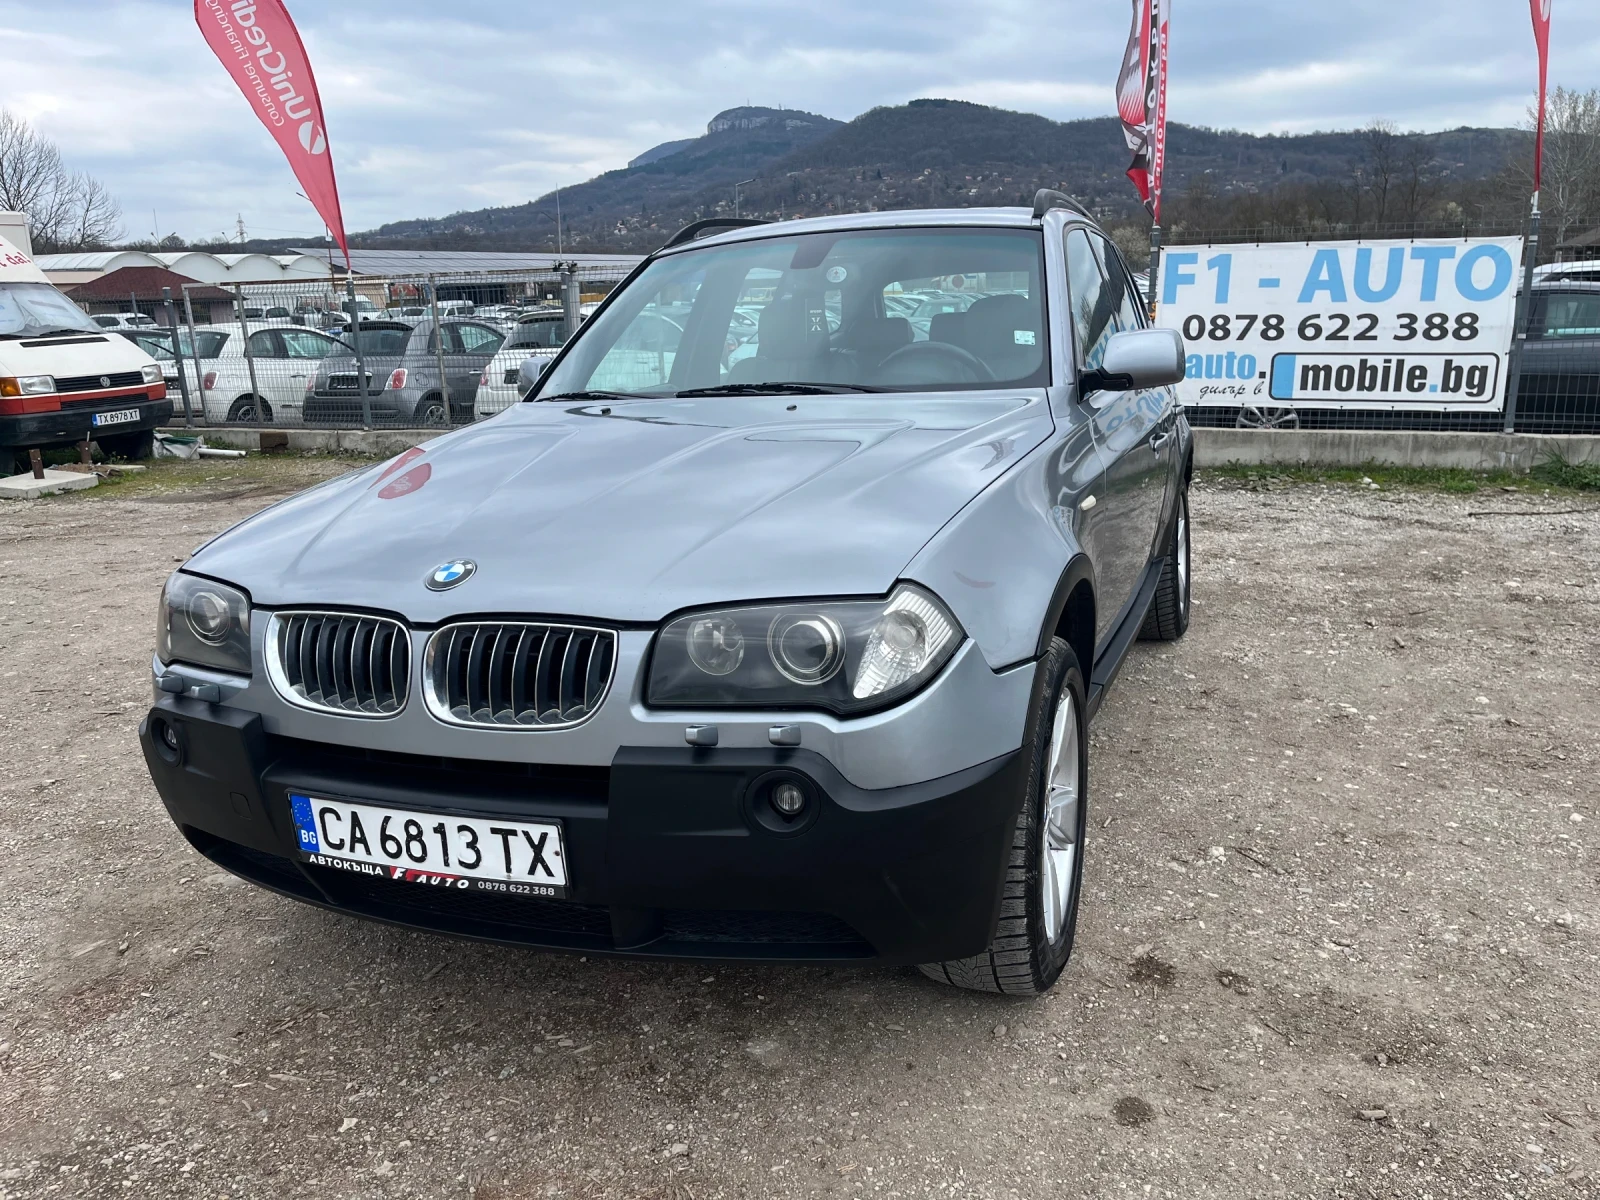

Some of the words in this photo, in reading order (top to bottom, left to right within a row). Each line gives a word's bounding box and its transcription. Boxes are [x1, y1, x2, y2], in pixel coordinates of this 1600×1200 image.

[1162, 252, 1232, 305] F1
[1297, 244, 1513, 304] AUTO
[1182, 314, 1285, 341] 0878
[1297, 313, 1379, 341] 622
[1393, 312, 1479, 341] 388
[1299, 358, 1489, 398] mobile.bg
[301, 829, 317, 844] BG
[309, 854, 383, 875] АВТОКЪЩА
[416, 874, 469, 889] AUTO
[478, 881, 507, 892] 0878
[509, 884, 530, 894] 622
[532, 886, 555, 896] 388
